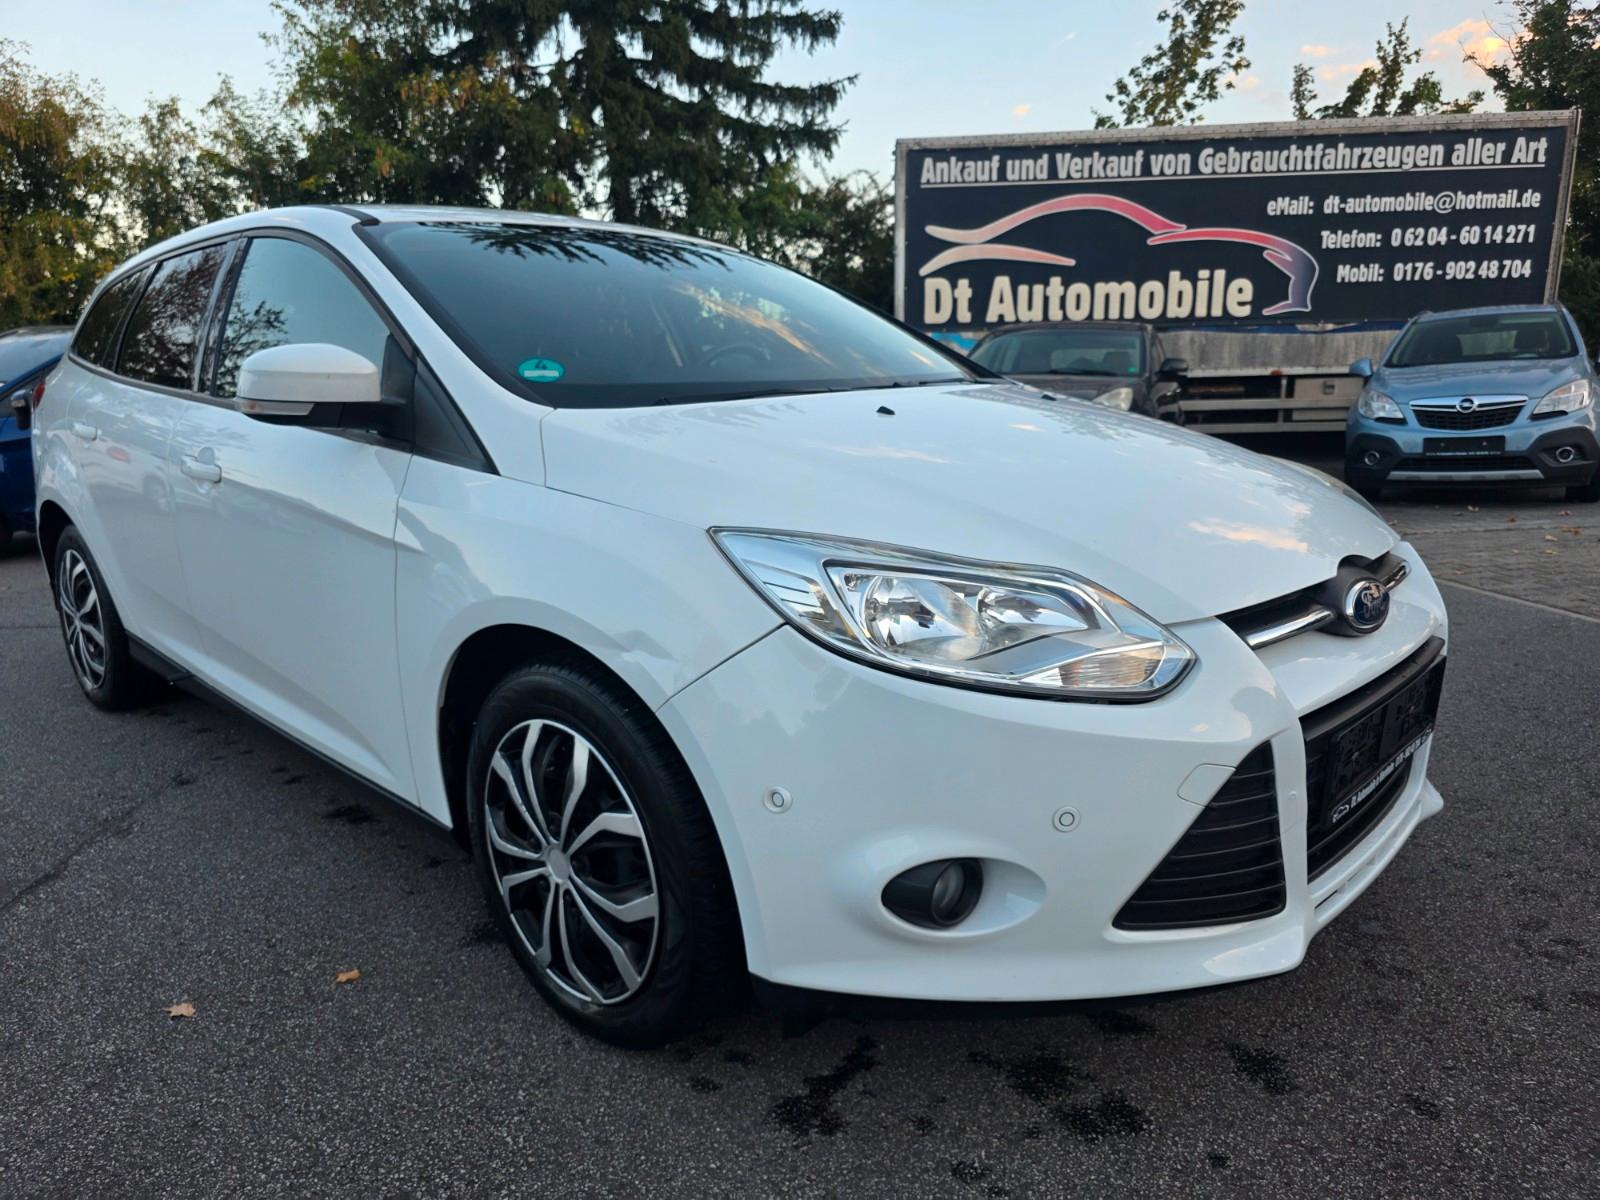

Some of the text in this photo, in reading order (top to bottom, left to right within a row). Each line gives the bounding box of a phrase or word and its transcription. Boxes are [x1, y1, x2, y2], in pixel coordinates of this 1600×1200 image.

[920, 136, 1548, 184] Ankauf und Verkauf von Gebrauchtfahrzeugen aller Art
[1267, 189, 1541, 216] eMail: dt-automobile@hotmail.de
[1320, 229, 1382, 249] Telefon:
[1336, 263, 1384, 283] Mobil:
[923, 269, 1253, 324] Dt Automobile
[535, 360, 547, 370] 4
